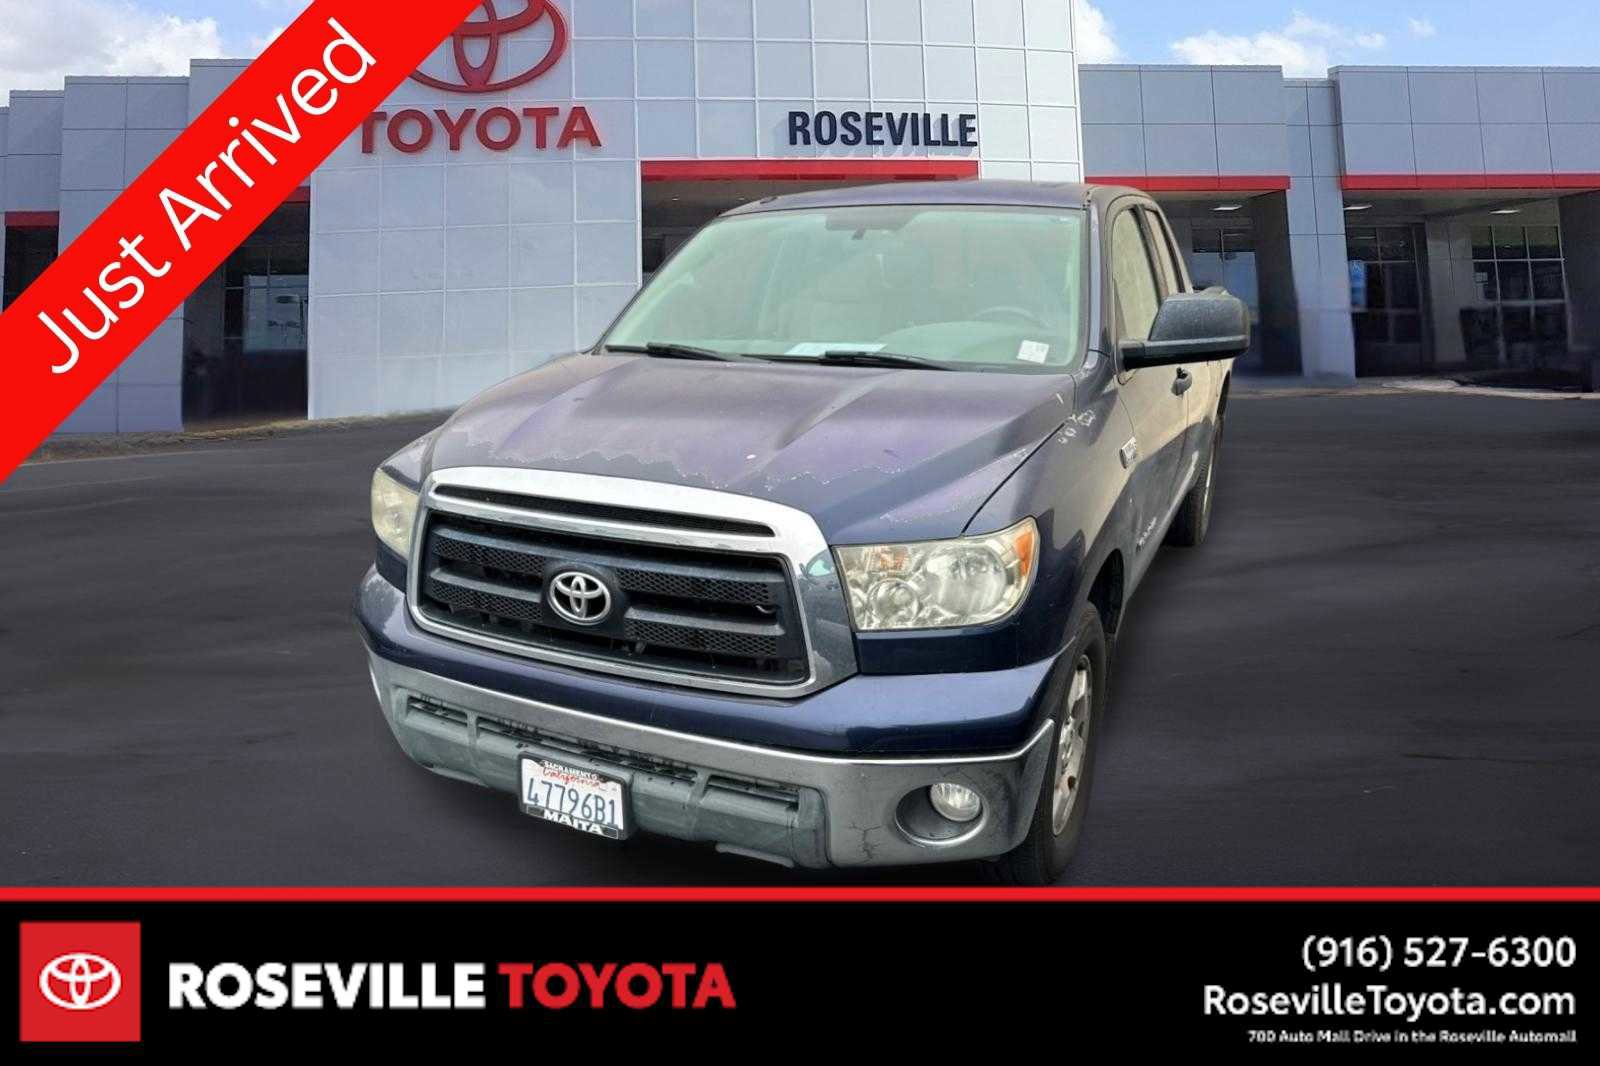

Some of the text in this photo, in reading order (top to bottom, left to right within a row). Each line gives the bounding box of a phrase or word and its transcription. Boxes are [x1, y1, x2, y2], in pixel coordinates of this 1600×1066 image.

[361, 106, 602, 154] TOYOTA
[788, 110, 978, 147] ROSEVILLE
[527, 777, 618, 828] 47796B1
